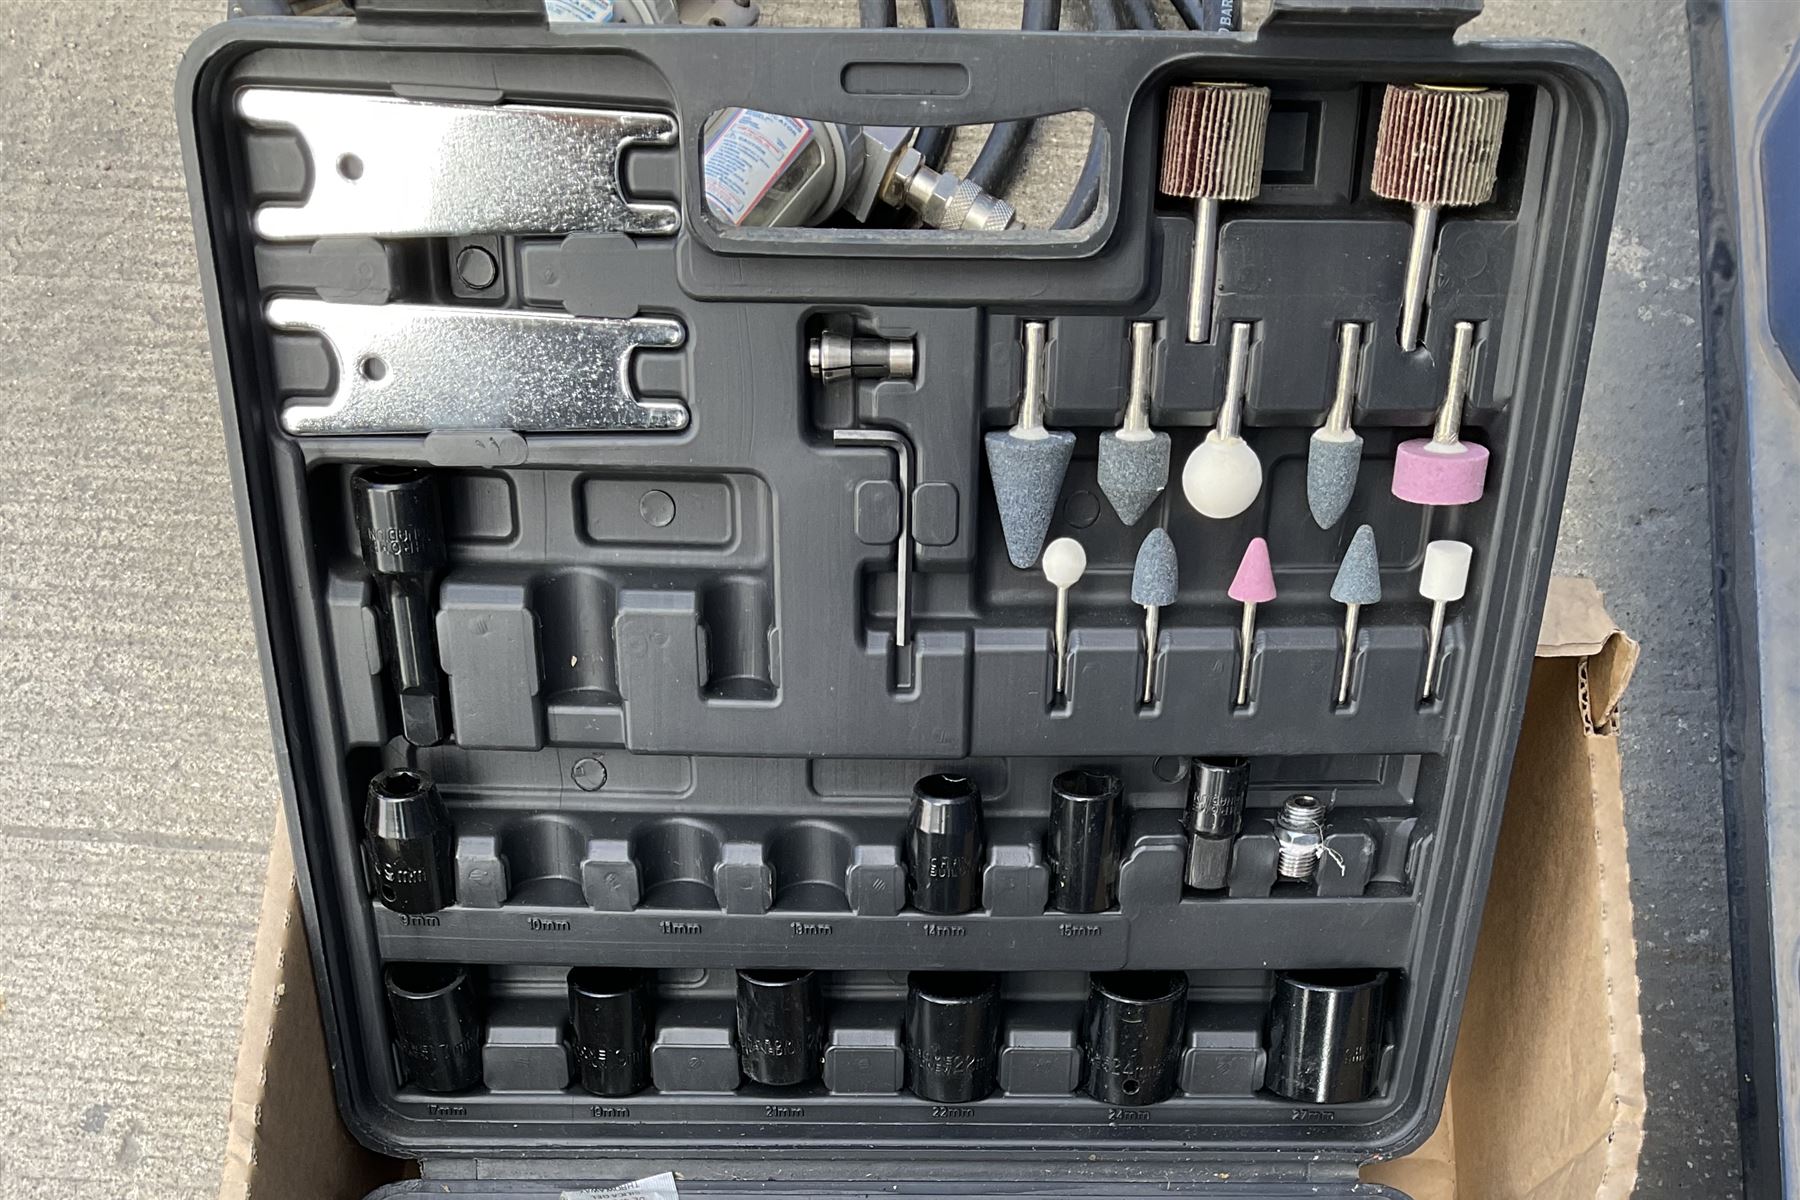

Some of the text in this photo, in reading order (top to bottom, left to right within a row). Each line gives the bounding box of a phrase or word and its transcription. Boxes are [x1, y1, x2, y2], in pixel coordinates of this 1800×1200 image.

[528, 917, 571, 931] 10mm
[659, 921, 702, 935] 11mm
[923, 923, 967, 937] 14mm
[1059, 923, 1102, 937] 15mm
[427, 1104, 467, 1117] 17mm
[590, 1105, 630, 1118] 19mm
[765, 1105, 805, 1118] 21mm
[932, 1106, 975, 1119] 22mm
[1108, 1107, 1150, 1120] 24mm
[1291, 1108, 1334, 1121] 27mm
